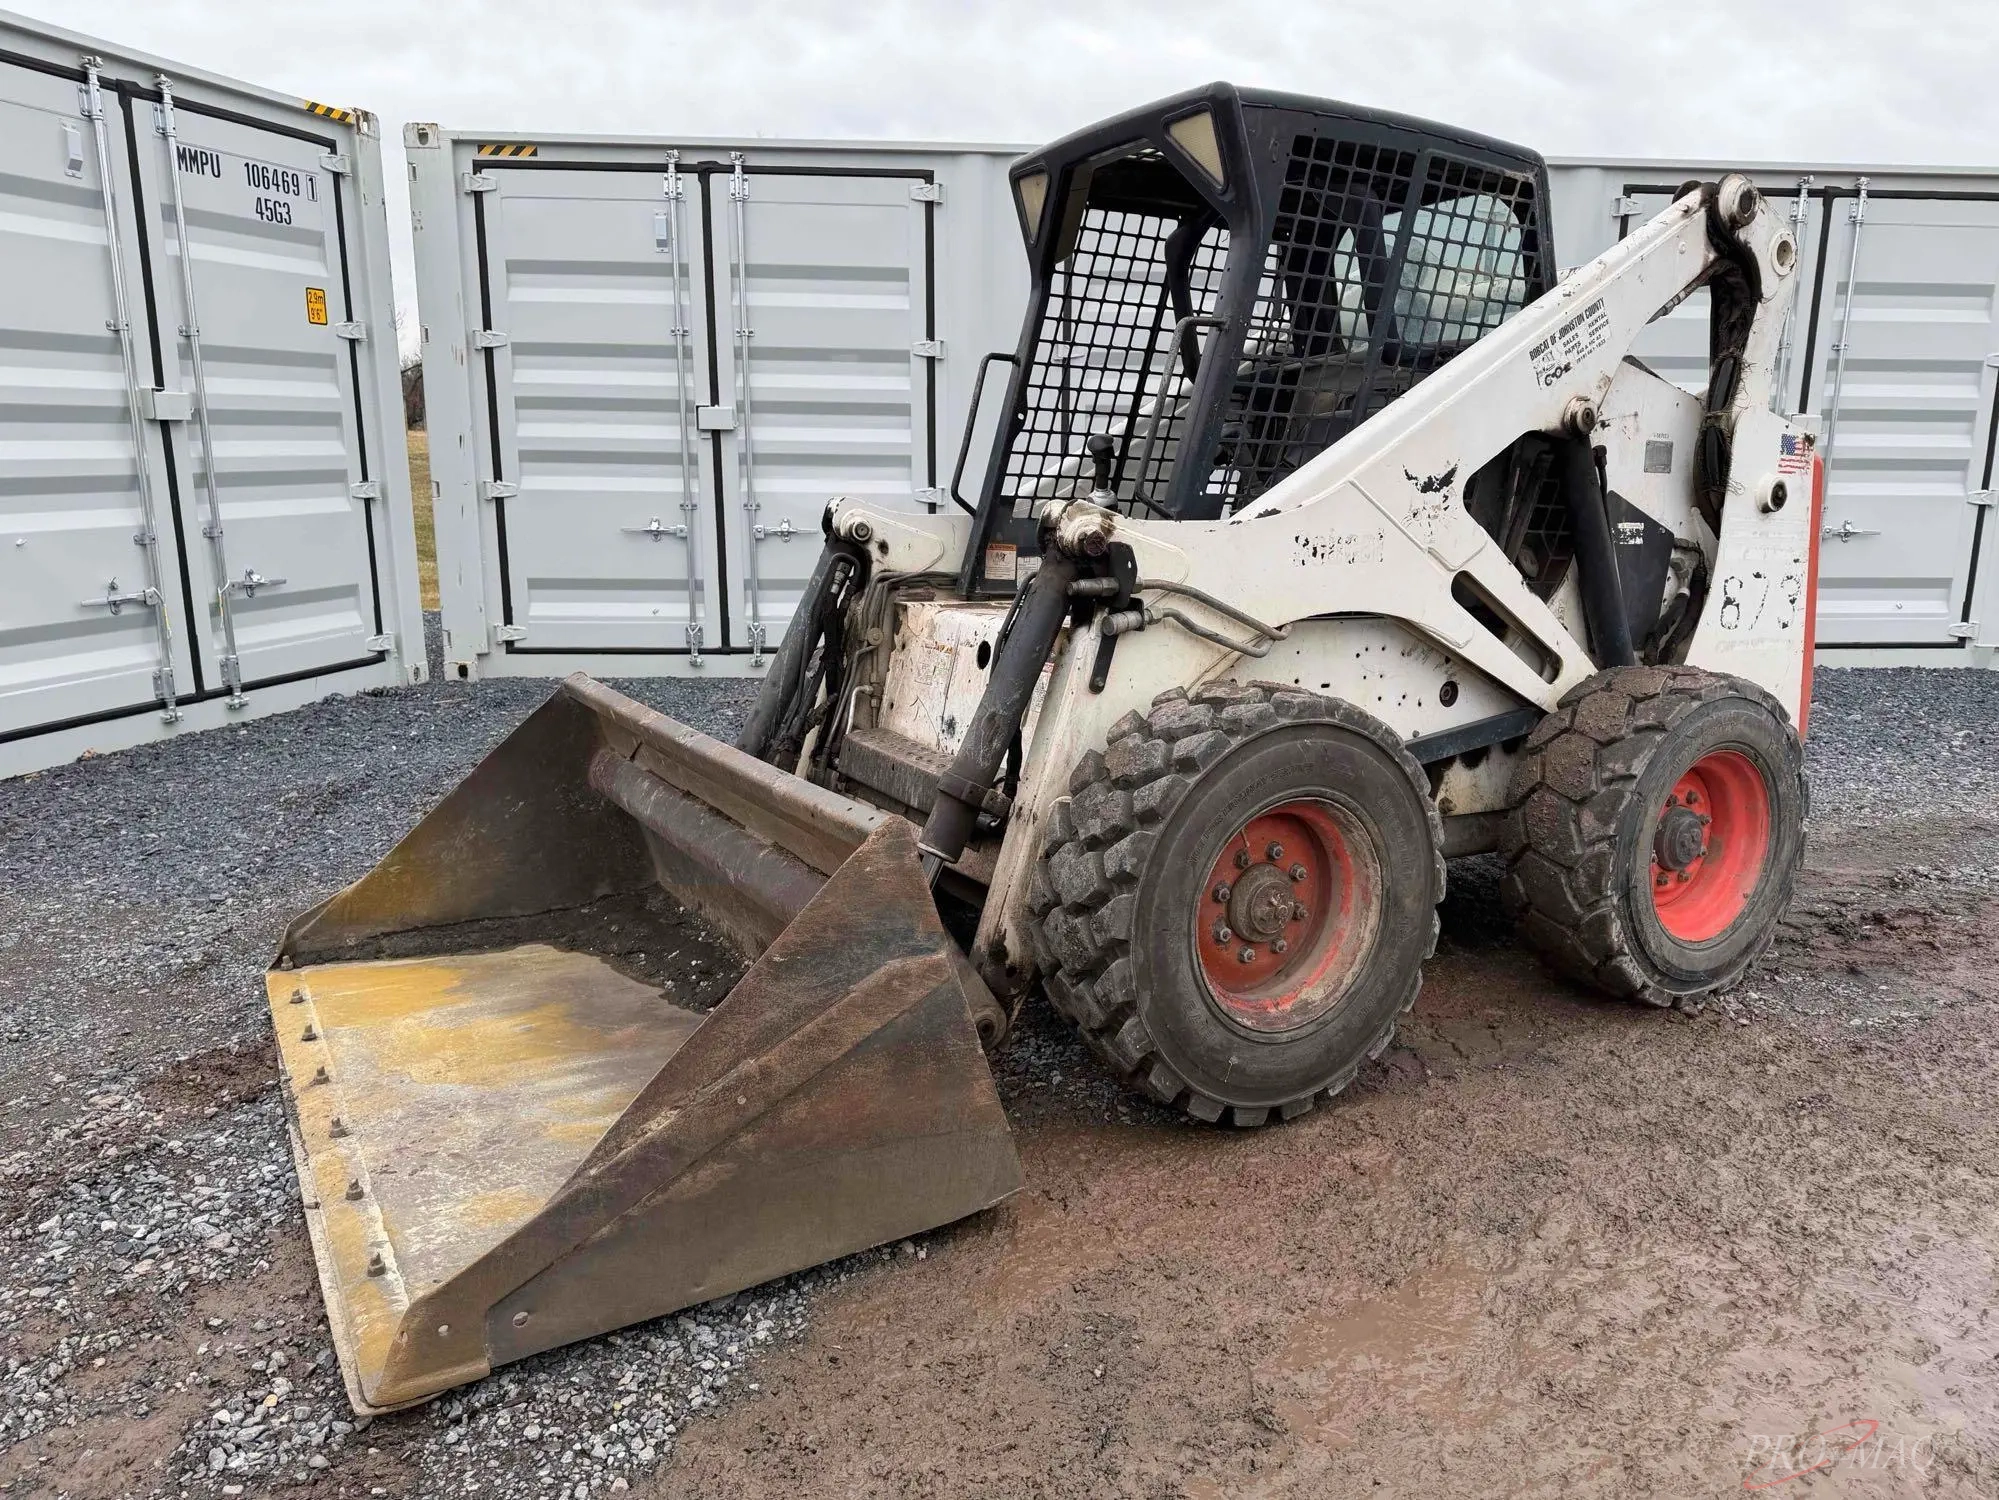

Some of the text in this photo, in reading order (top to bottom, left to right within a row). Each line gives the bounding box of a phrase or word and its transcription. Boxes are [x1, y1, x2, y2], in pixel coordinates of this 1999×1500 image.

[176, 145, 316, 201] MMPU 106469 1
[255, 197, 292, 225] 45G3
[1529, 297, 1605, 361] BOBCAT OF JOHNSTON COUNTY
[1562, 312, 1607, 348] SALES RENTAL
[1564, 319, 1609, 356] PARTS SERVICE
